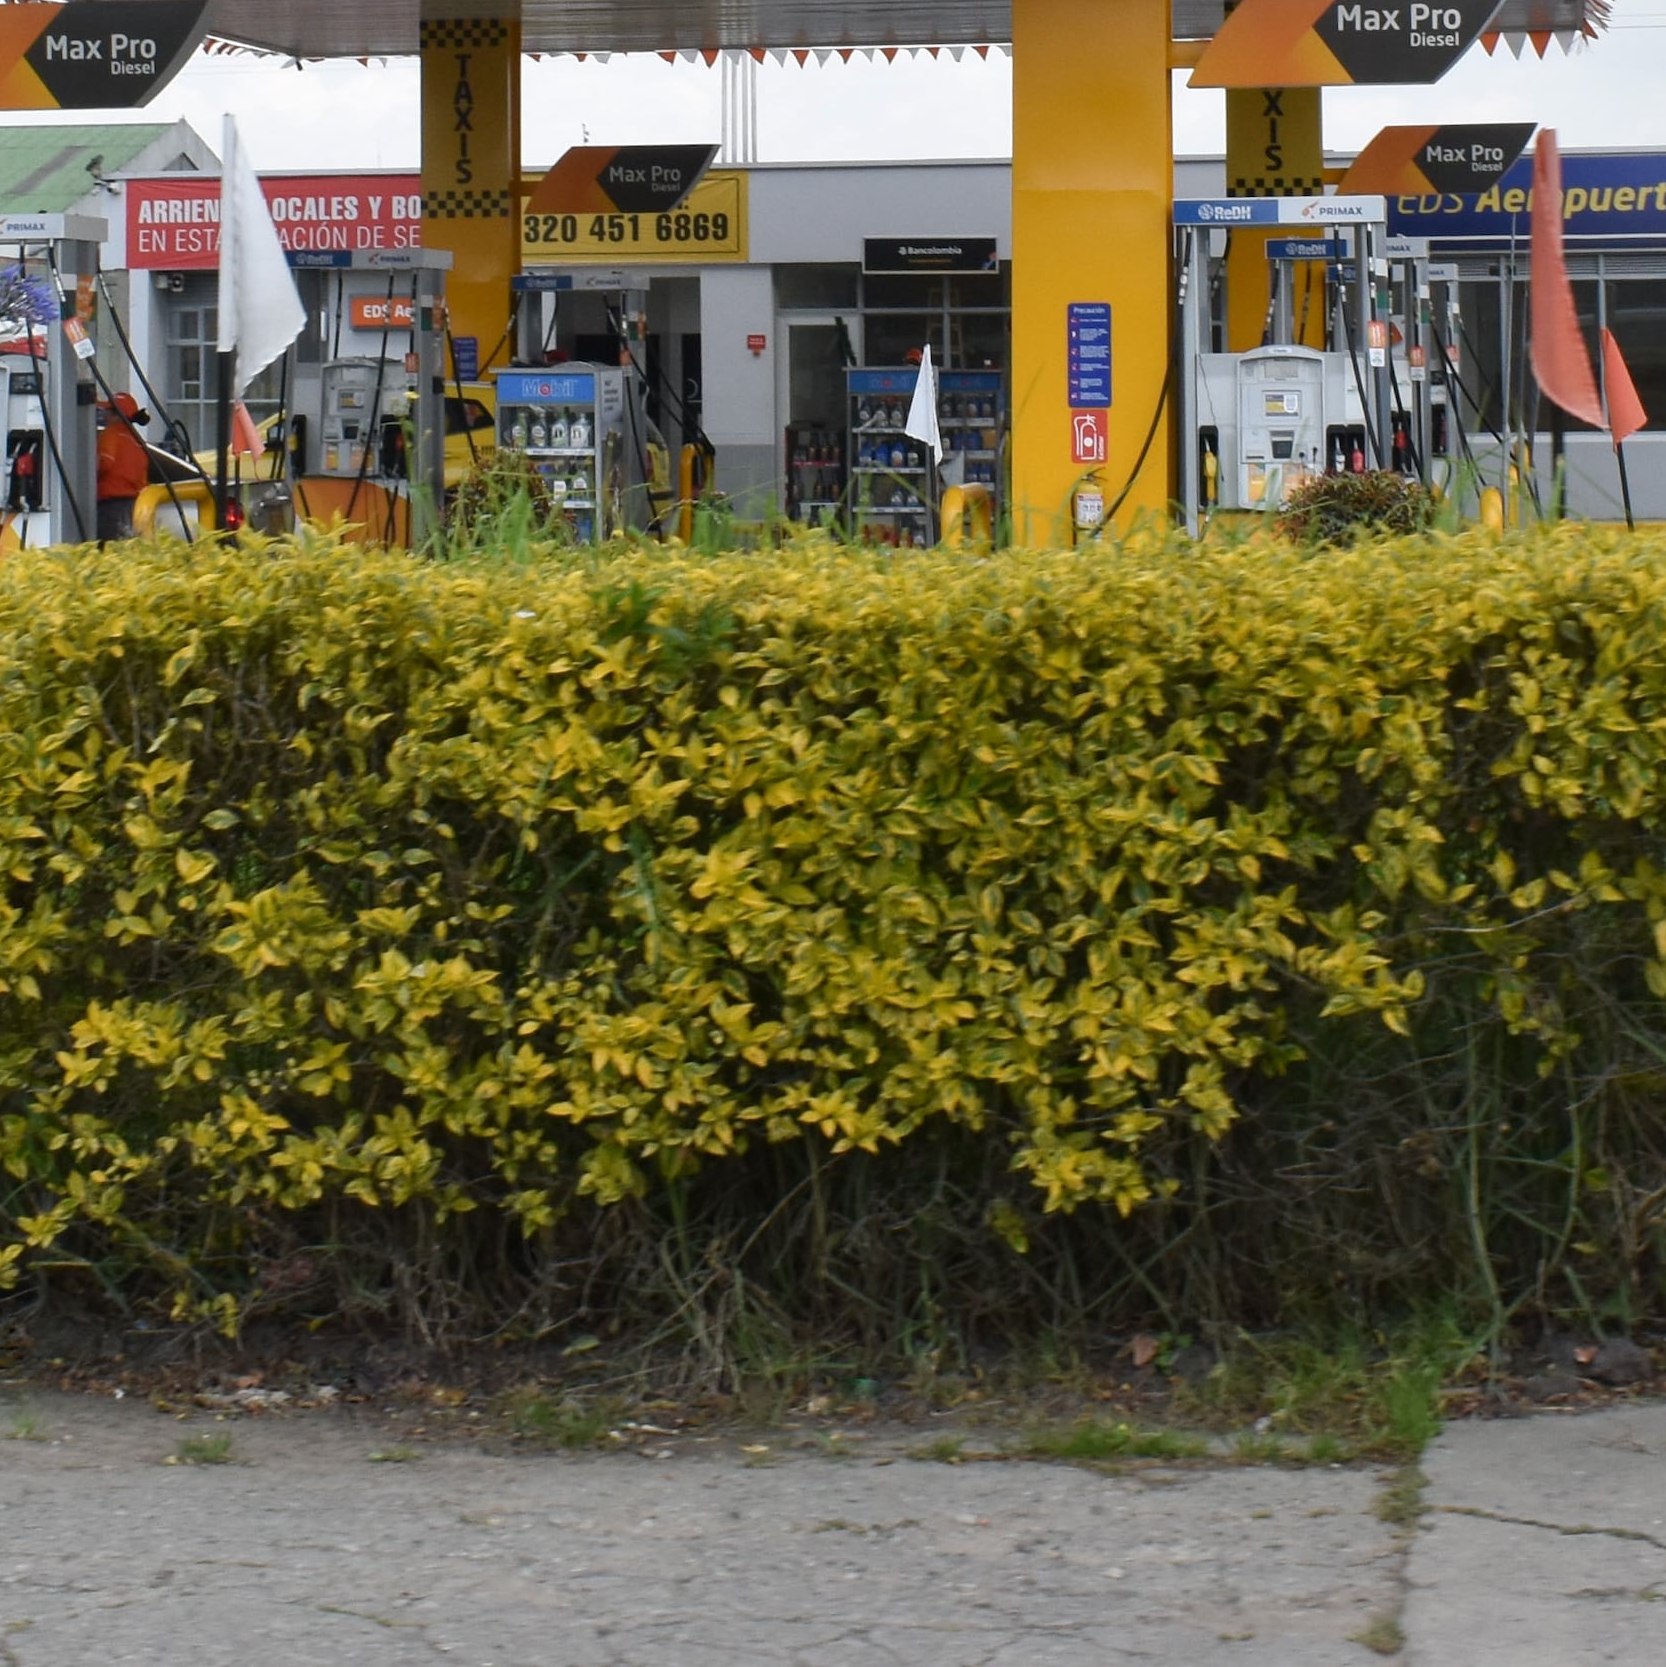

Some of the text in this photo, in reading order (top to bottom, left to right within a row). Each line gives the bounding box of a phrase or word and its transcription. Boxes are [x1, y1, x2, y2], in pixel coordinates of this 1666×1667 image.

[1337, 3, 1462, 31] Max Pro
[46, 34, 156, 60] Max Pro
[1410, 32, 1460, 47] Diesel
[111, 60, 155, 75] Diesel
[453, 53, 474, 183] TAXIS
[1262, 90, 1284, 171] XIS
[1427, 144, 1503, 162] Max Pro
[609, 165, 681, 182] Max Pro
[1472, 162, 1503, 172] Diesel
[652, 182, 681, 191] Diesel
[138, 195, 422, 224] ARRIEN OCALES Y BO
[1214, 205, 1251, 220] ReDH
[1319, 206, 1363, 216] PRIMAX
[1397, 193, 1464, 215] EDS
[6, 222, 46, 232] PRIMAX
[524, 213, 729, 243] 320 451 6869
[139, 229, 166, 253] EN
[280, 222, 347, 251] ACIÓN
[357, 225, 384, 249] DE
[394, 225, 422, 249] SE
[907, 245, 963, 255] Bancolombia
[395, 304, 414, 318] Ae
